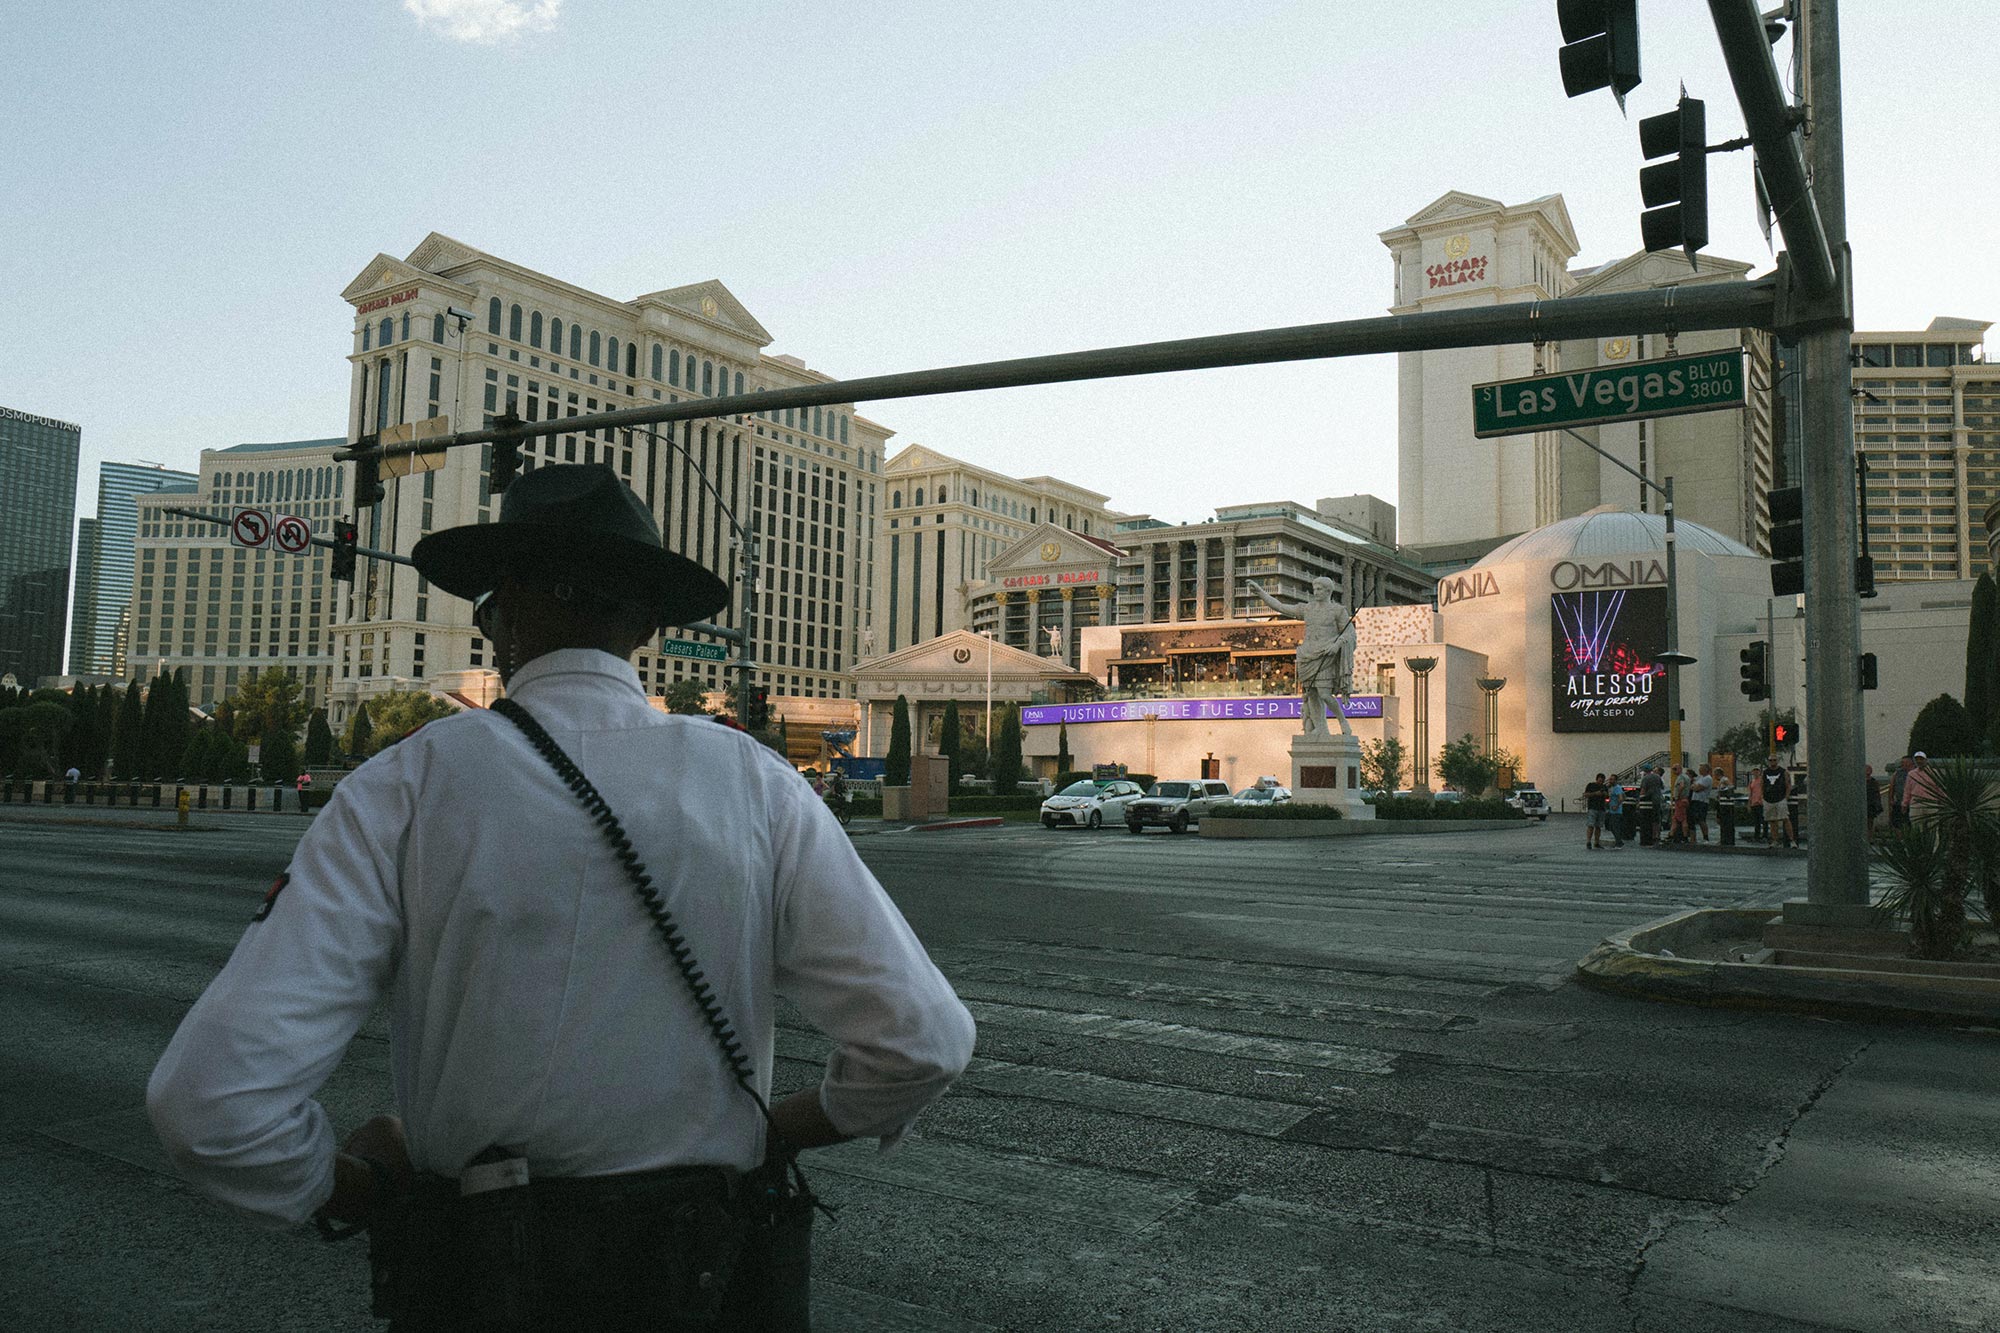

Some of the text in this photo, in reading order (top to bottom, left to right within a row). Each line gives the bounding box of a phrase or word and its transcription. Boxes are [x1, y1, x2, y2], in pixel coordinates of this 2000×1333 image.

[1426, 255, 1488, 277] CAESARS
[1430, 268, 1484, 289] PALACE
[1483, 361, 1730, 418] S Las Vegas BLVD
[1690, 379, 1733, 399] 3800
[1003, 570, 1099, 588] CAESARS PALACE
[1551, 559, 1668, 590] OMNIA
[1437, 570, 1500, 607] OMNIA
[665, 641, 693, 655] Caesars
[695, 644, 718, 658] Palace
[1567, 673, 1652, 696] ALESSO
[1063, 707, 1105, 720] JUSTIN
[1111, 704, 1191, 719] CREDIBLE
[1200, 703, 1234, 716] TUE
[1243, 702, 1279, 716] SEP
[1570, 698, 1594, 711] CITY
[1604, 695, 1649, 707] DREAMS
[1583, 708, 1635, 717] SAT SEP 10
